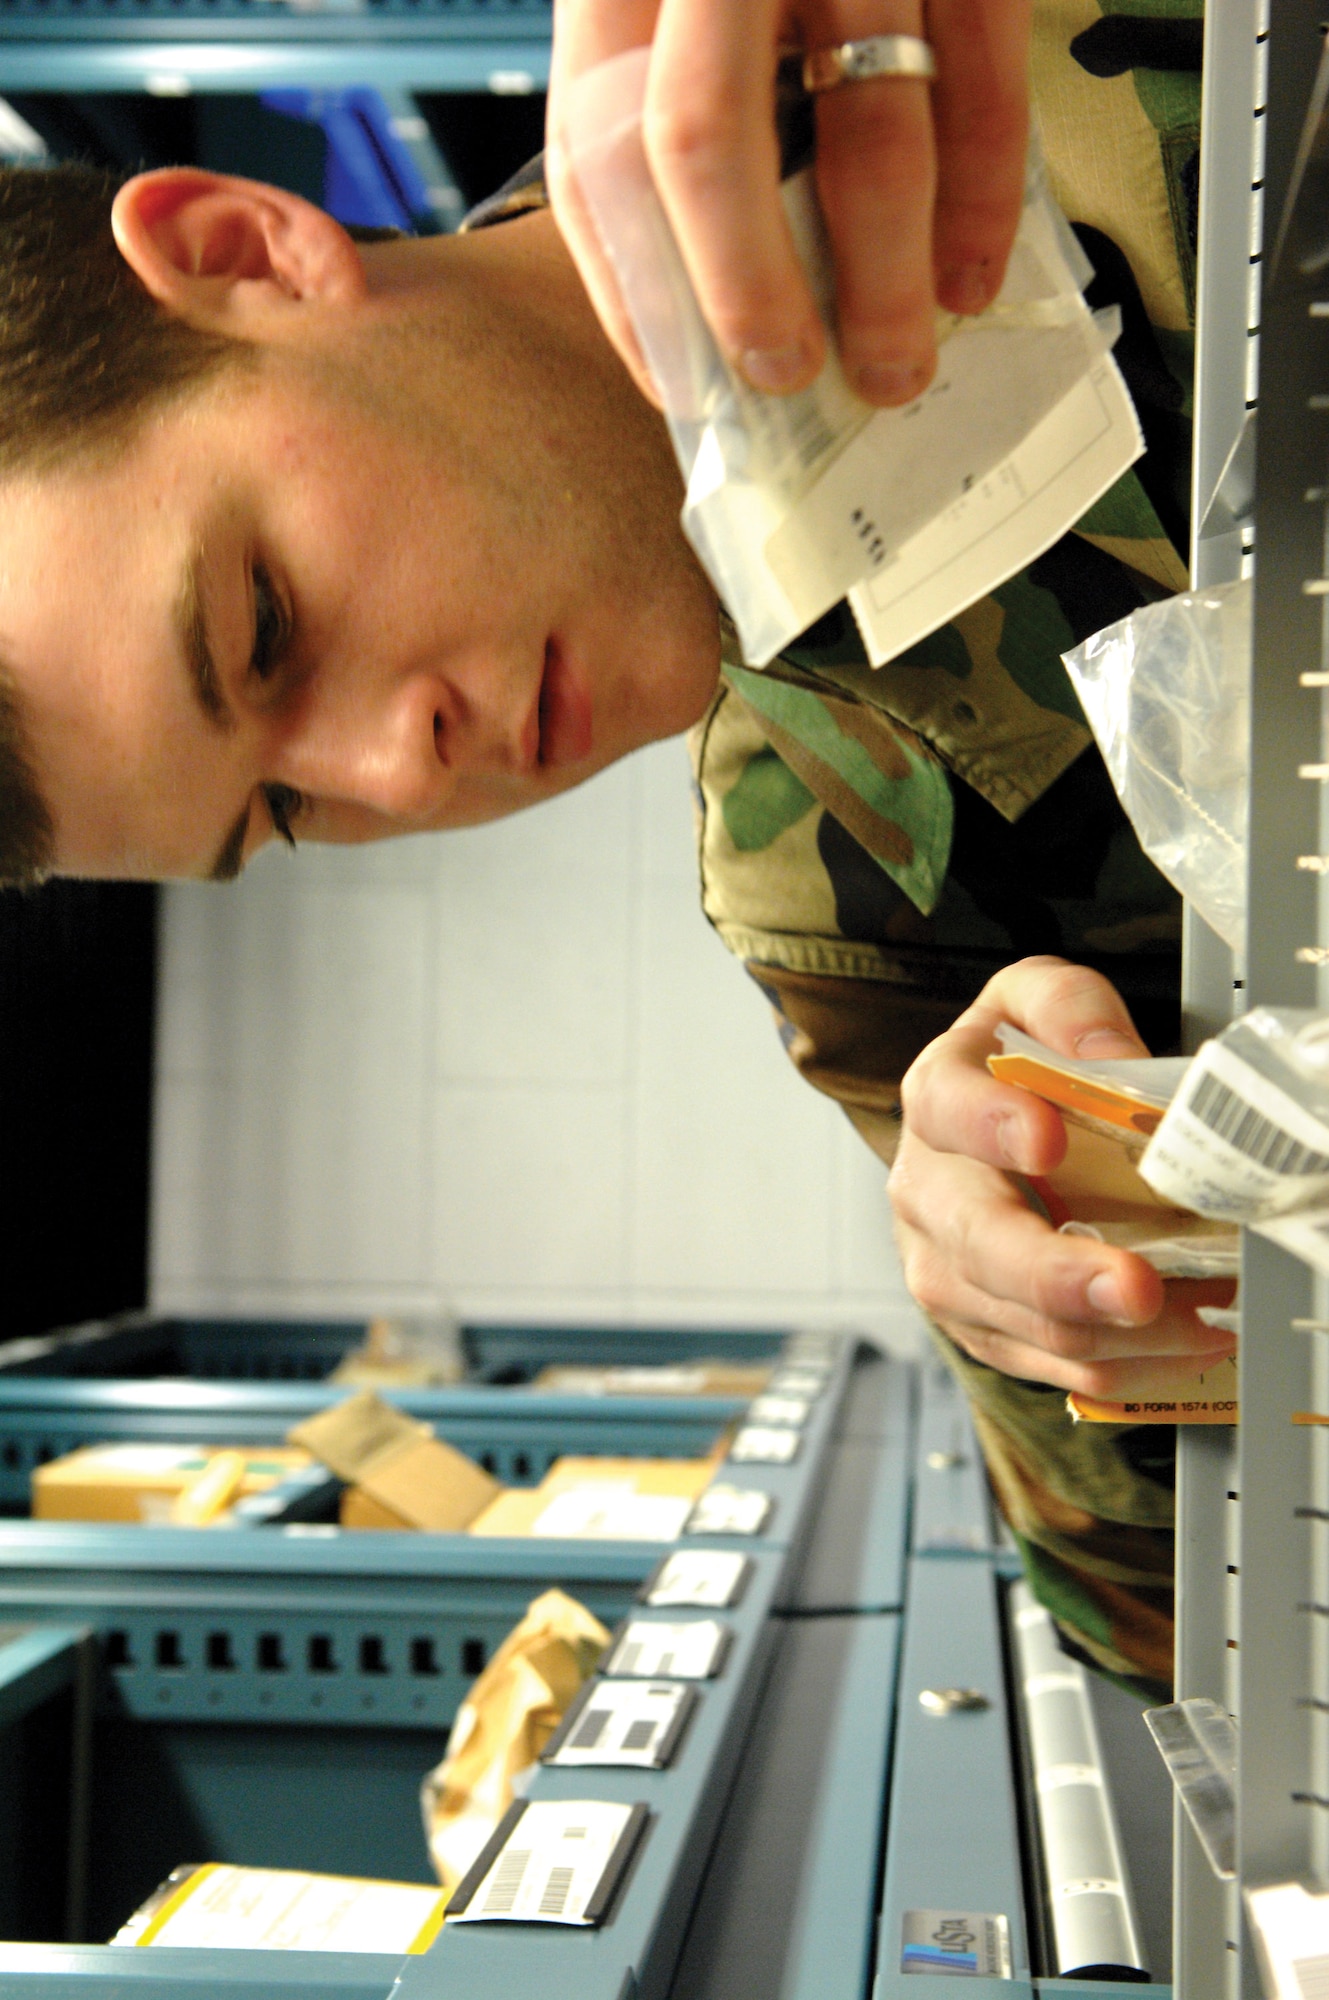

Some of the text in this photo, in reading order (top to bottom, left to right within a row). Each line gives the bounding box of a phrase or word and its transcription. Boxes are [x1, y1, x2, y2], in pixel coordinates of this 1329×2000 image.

[1144, 1402, 1176, 1412] FORM
[1181, 1401, 1208, 1411] 1574
[932, 1919, 976, 1953] LISTA
